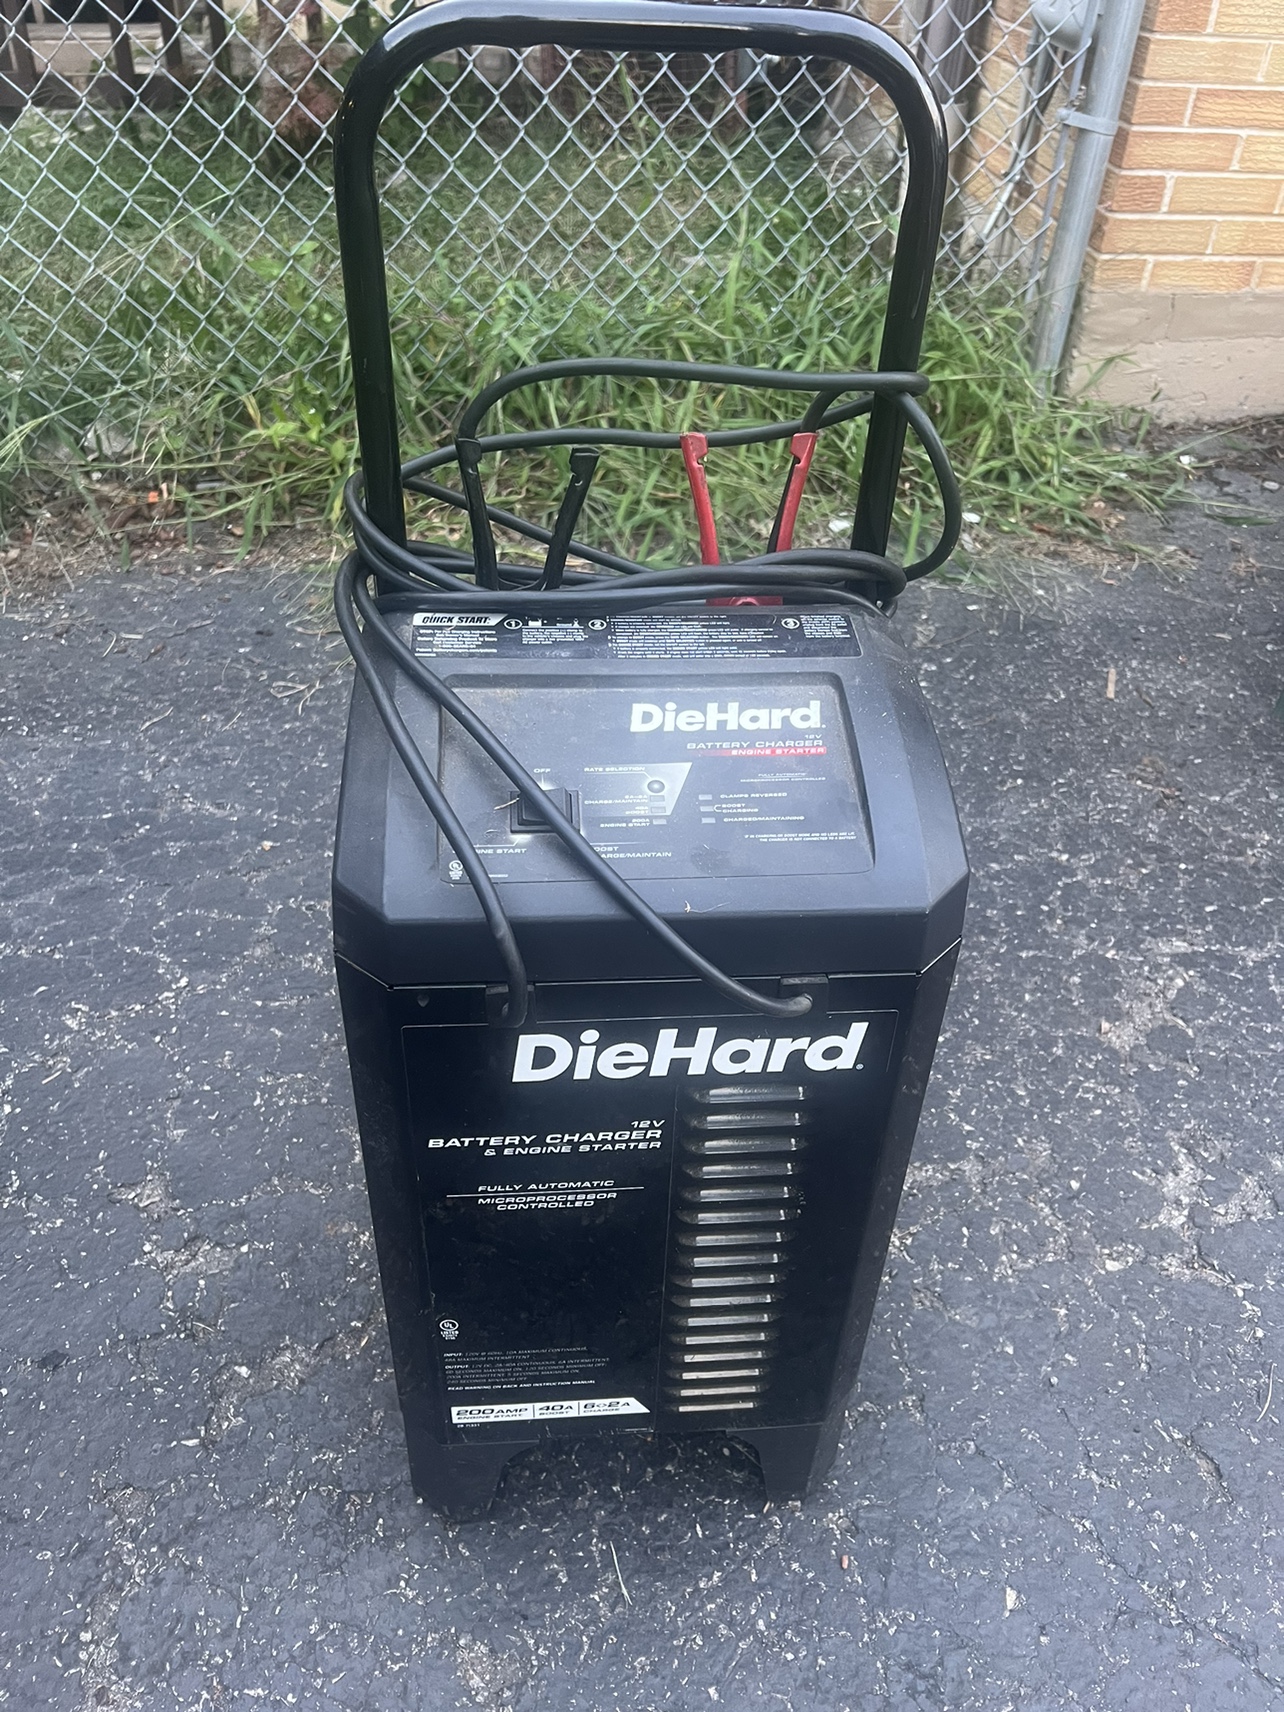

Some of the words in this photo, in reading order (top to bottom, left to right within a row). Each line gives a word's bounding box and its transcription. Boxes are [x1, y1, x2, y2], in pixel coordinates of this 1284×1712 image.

[422, 616, 454, 624] QUICK
[456, 616, 491, 624] START:
[755, 740, 823, 748] CHARGER
[631, 1119, 665, 1128] 12V
[428, 1135, 537, 1148] BATTERY
[545, 1129, 663, 1144] CHARGER
[484, 1148, 496, 1156] &
[503, 1145, 572, 1155] ENGINE
[578, 1141, 662, 1152] STARTER
[478, 1184, 523, 1192] FULLY
[527, 1180, 615, 1190] AUTOMATIC
[478, 1192, 617, 1205] MICROPROCESSOR
[497, 1200, 594, 1210] CONTROLLED
